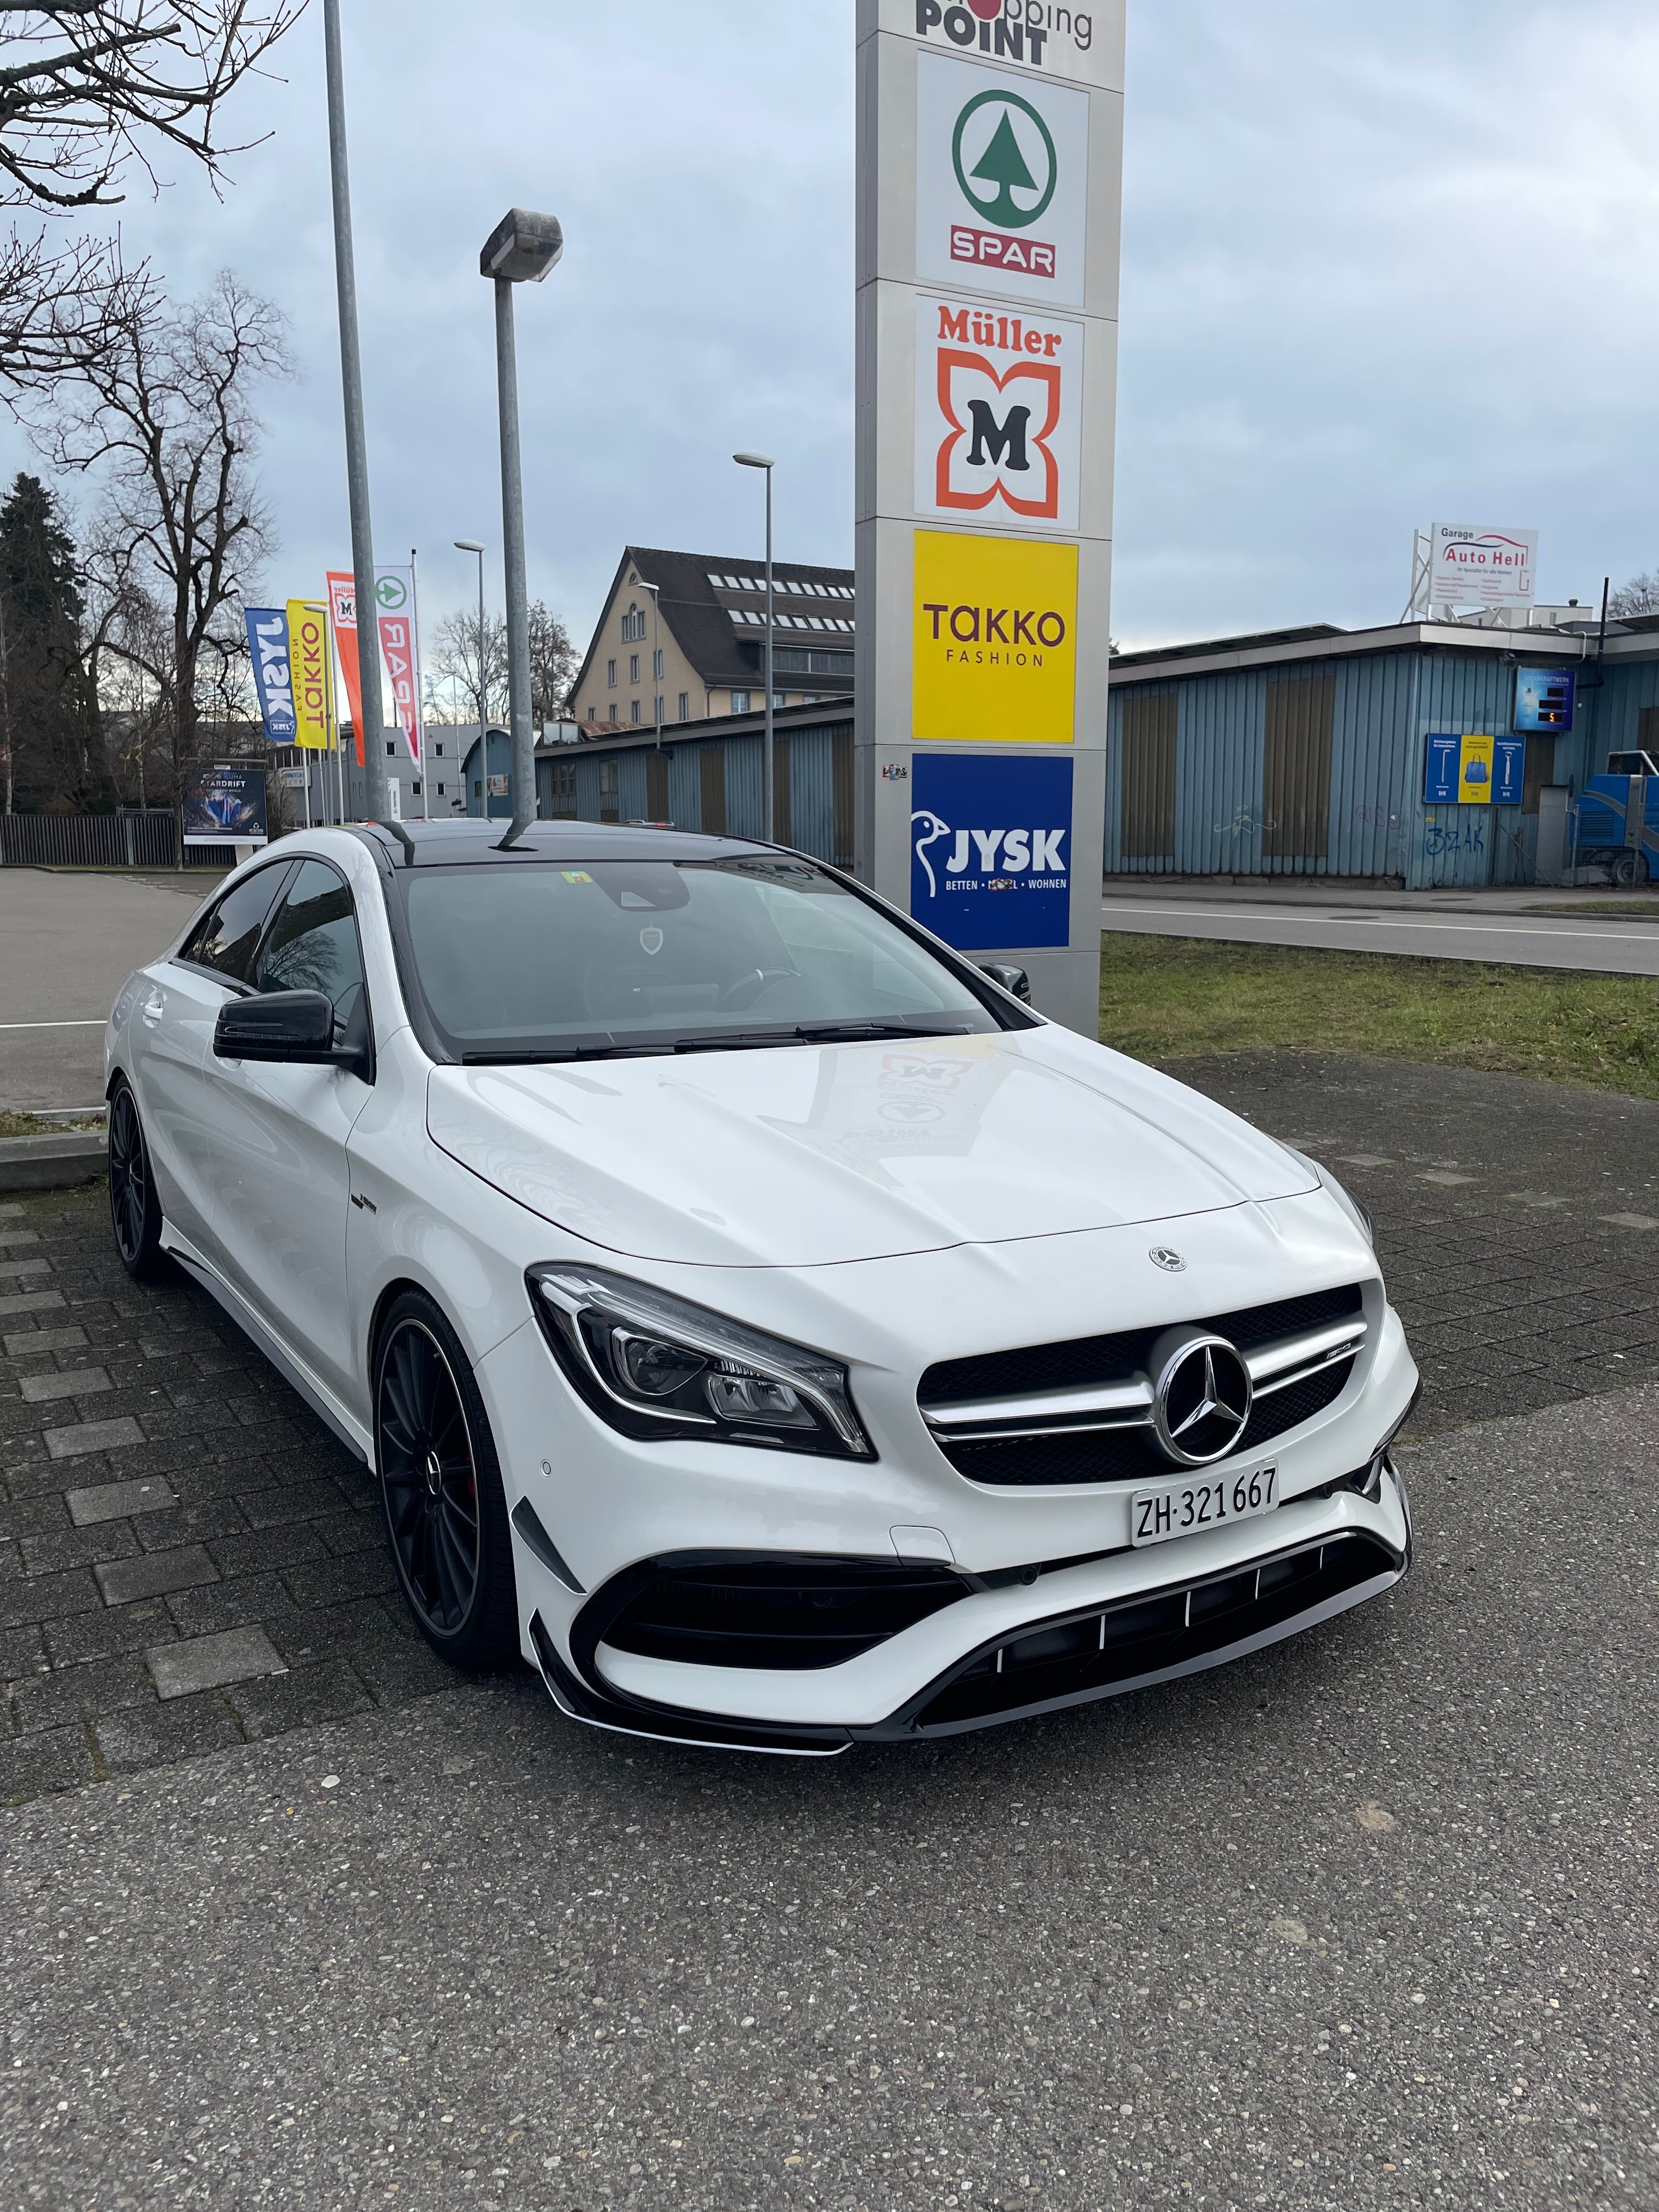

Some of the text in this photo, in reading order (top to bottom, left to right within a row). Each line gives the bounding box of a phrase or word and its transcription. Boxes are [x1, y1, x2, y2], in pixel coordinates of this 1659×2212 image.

[916, 0, 1047, 65] POINT
[953, 231, 1052, 273] SPAR
[938, 306, 1062, 357] Müller
[967, 399, 1031, 471] M
[1442, 528, 1474, 540] Garage
[1446, 549, 1525, 566] Auto Hell
[946, 650, 1043, 667] FASHION
[946, 829, 1066, 872] JYSK
[946, 881, 978, 890] BETTEN
[1028, 879, 1066, 889] WOHNEN
